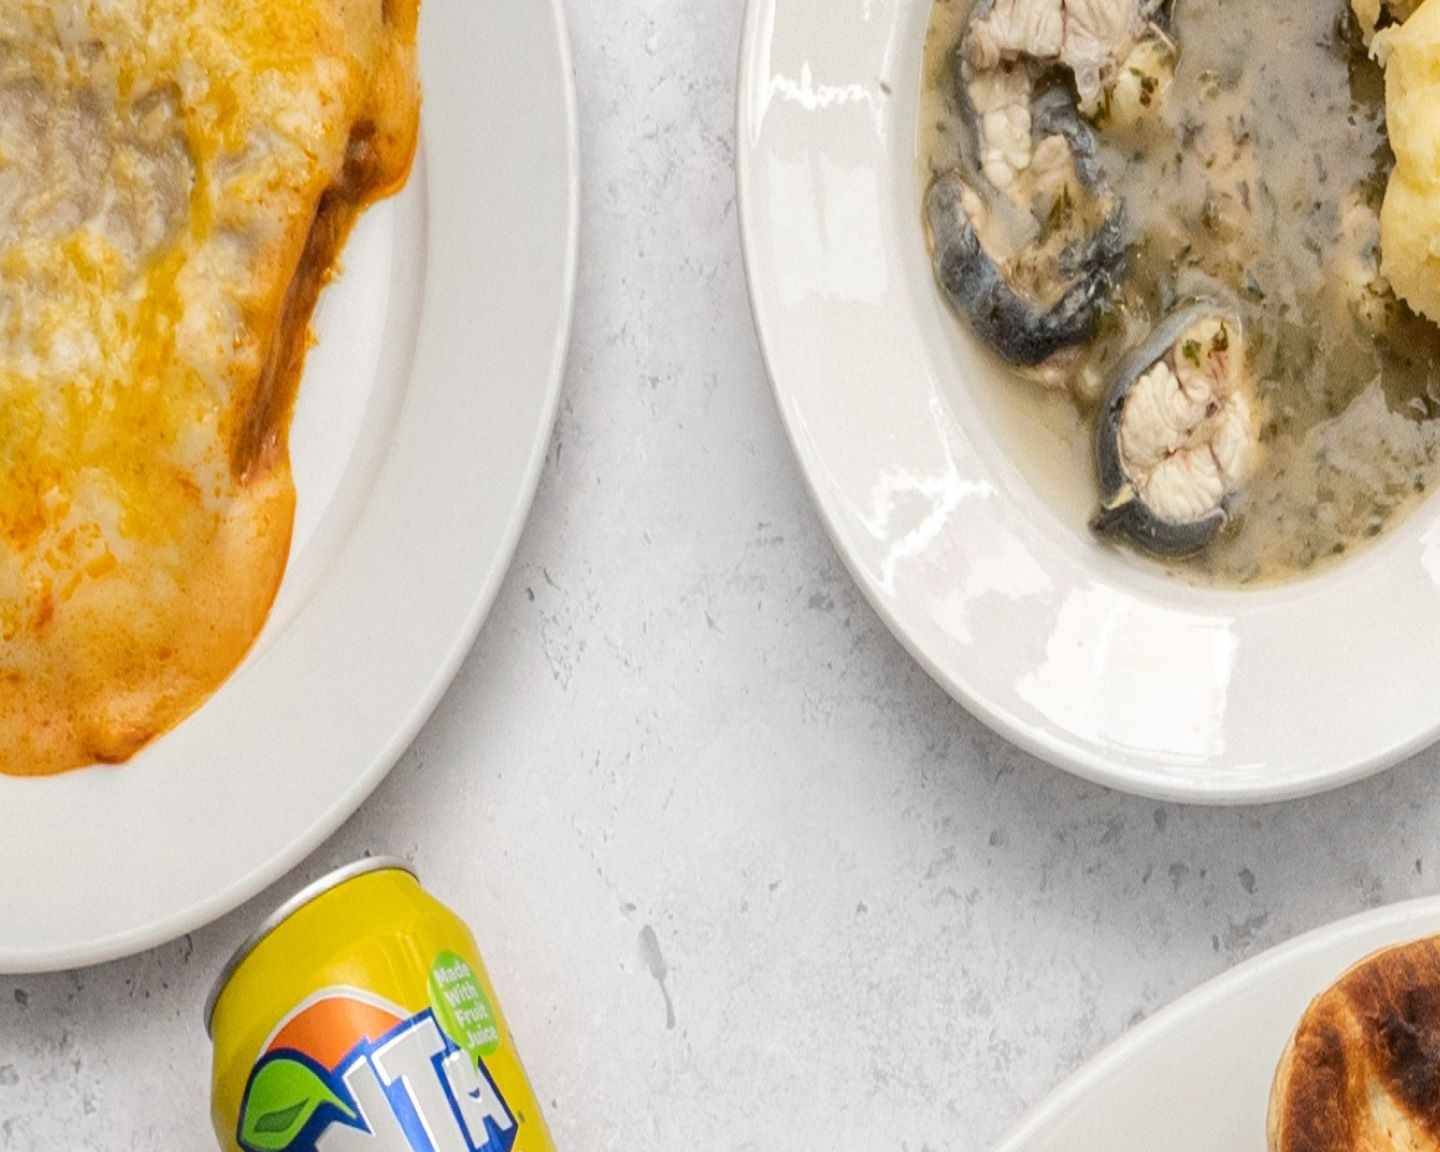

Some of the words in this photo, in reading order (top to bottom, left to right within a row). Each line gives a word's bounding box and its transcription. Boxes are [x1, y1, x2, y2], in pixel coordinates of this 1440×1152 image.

[433, 960, 471, 985] Made
[444, 981, 479, 1007] With
[455, 1002, 489, 1029] Fruit
[467, 1025, 498, 1048] Juice
